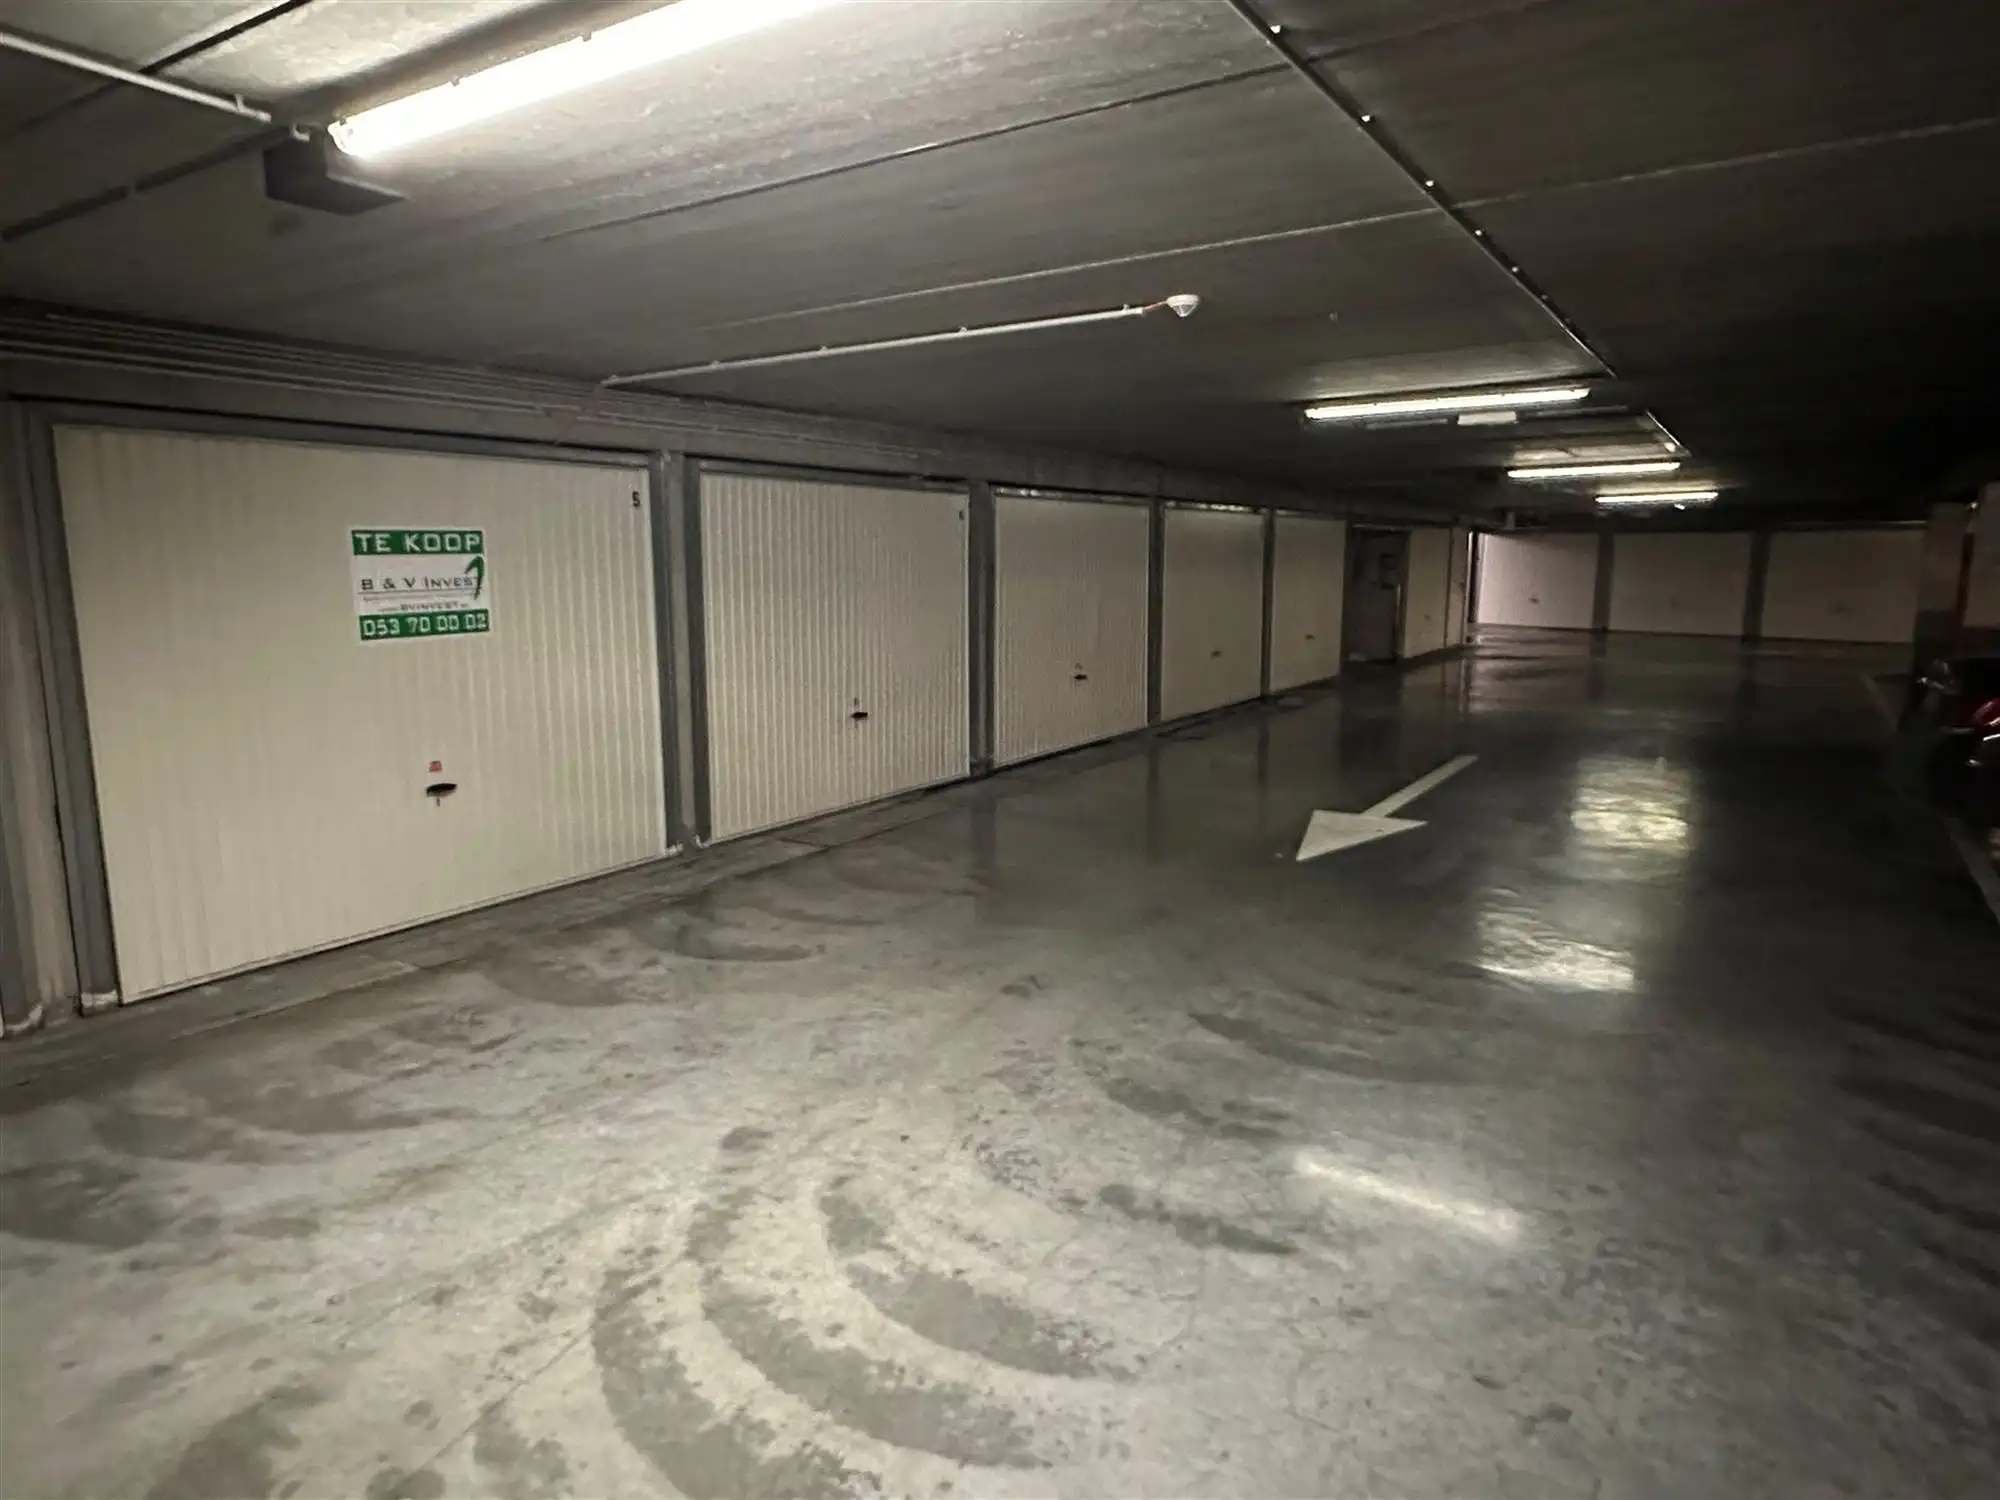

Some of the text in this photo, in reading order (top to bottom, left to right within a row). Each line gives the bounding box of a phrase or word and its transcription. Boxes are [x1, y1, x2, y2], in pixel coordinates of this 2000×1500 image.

[355, 533, 480, 552] TE KOOP
[361, 579, 374, 590] B
[384, 578, 396, 590] &
[403, 577, 416, 588] V
[363, 618, 401, 636] 053
[406, 617, 431, 633] 70
[437, 615, 459, 631] 00
